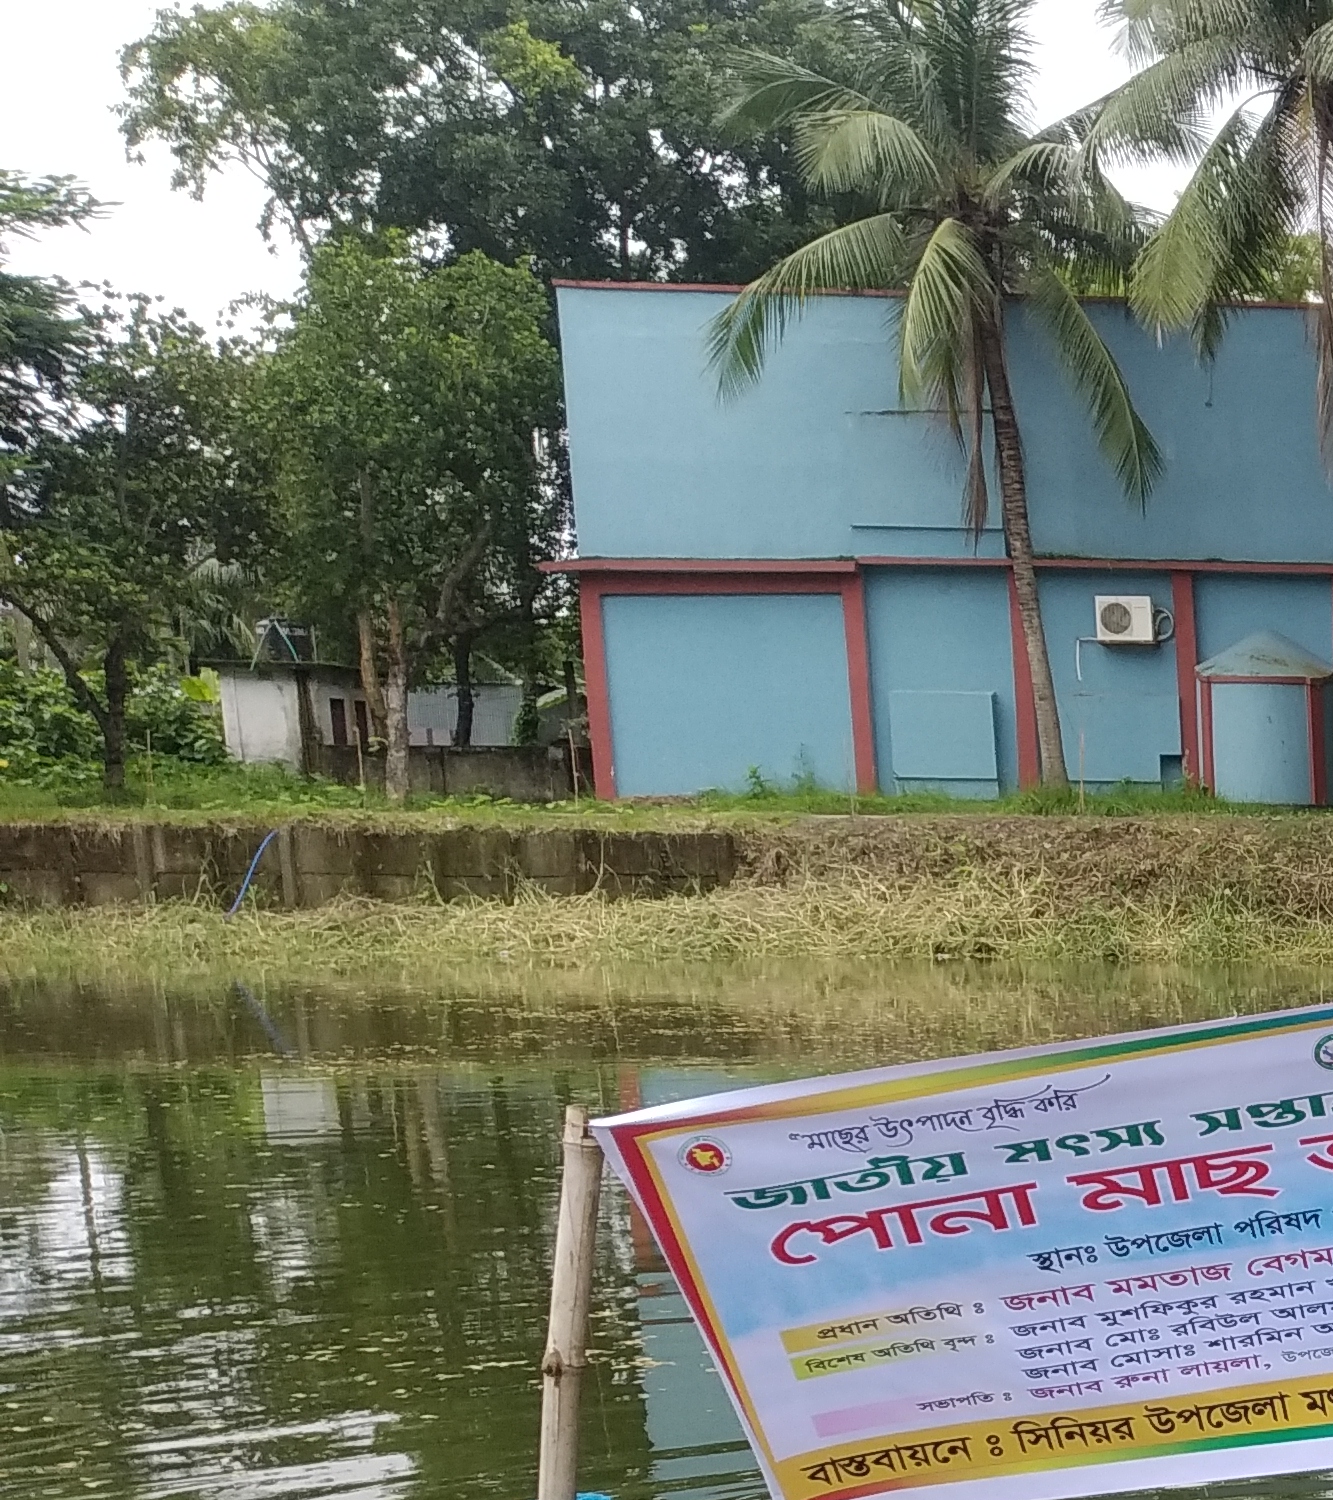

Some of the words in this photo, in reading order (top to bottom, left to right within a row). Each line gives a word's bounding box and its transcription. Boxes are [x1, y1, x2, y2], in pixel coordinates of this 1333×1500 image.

[1033, 1073, 1112, 1114] করি
[723, 1152, 968, 1210] জাতীয়
[993, 1120, 1165, 1163] মৎস্য
[771, 1182, 1037, 1265] পোনা
[1066, 1145, 1281, 1210] মাছ
[1104, 1222, 1223, 1258] উপজেলা
[1234, 1207, 1323, 1239] পরিষদ
[805, 1352, 866, 1373] বিশেষ
[871, 1339, 935, 1357] অতিথি
[1008, 1315, 1088, 1338] জনাব
[1094, 1295, 1218, 1326] মুশফিকুর
[1226, 1281, 1316, 1304] রহমান
[817, 1318, 880, 1340] প্রধান
[884, 1302, 964, 1326] অতিথি
[998, 1283, 1096, 1312] জনাব
[1104, 1263, 1232, 1296] মমতাজ
[1015, 1337, 1094, 1360] জনাব
[1106, 1325, 1159, 1347] মোঃ
[1168, 1311, 1262, 1336] রবিউল
[1021, 1358, 1099, 1380] জনাব
[1111, 1344, 1195, 1369] মোসাঃ
[1204, 1326, 1304, 1352] শারমিন
[916, 1393, 995, 1412] সভাপতি
[1027, 1379, 1104, 1400] জনাব
[1111, 1368, 1171, 1389] রুনা
[1178, 1354, 1272, 1377] লায়লা,
[800, 1436, 971, 1486] বাস্তবায়নে
[1011, 1415, 1136, 1454] সিনিয়র
[1144, 1391, 1290, 1435] উপজেলা
